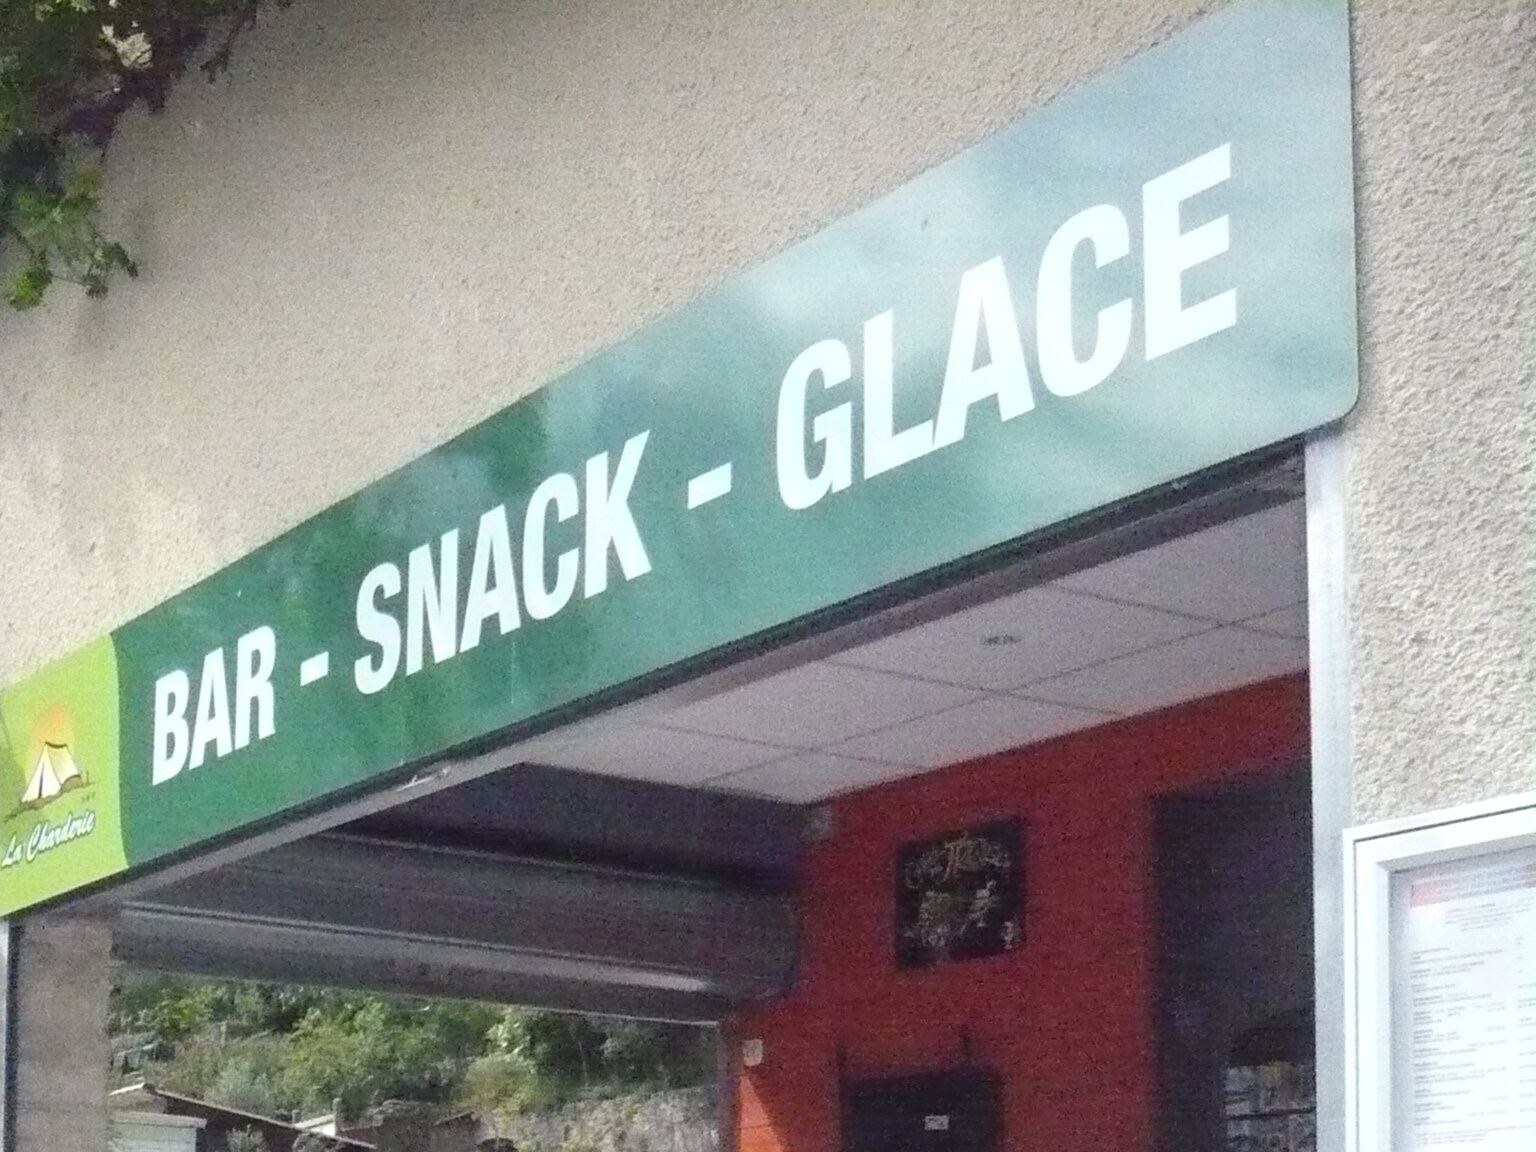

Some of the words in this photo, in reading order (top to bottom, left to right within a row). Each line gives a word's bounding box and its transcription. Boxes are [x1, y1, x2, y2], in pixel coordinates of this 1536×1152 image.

[152, 625, 277, 787] BAR
[300, 651, 330, 688] -
[353, 429, 653, 696] SNACK
[687, 461, 732, 510] -
[775, 141, 1238, 511] GLACE
[1, 832, 23, 870] La
